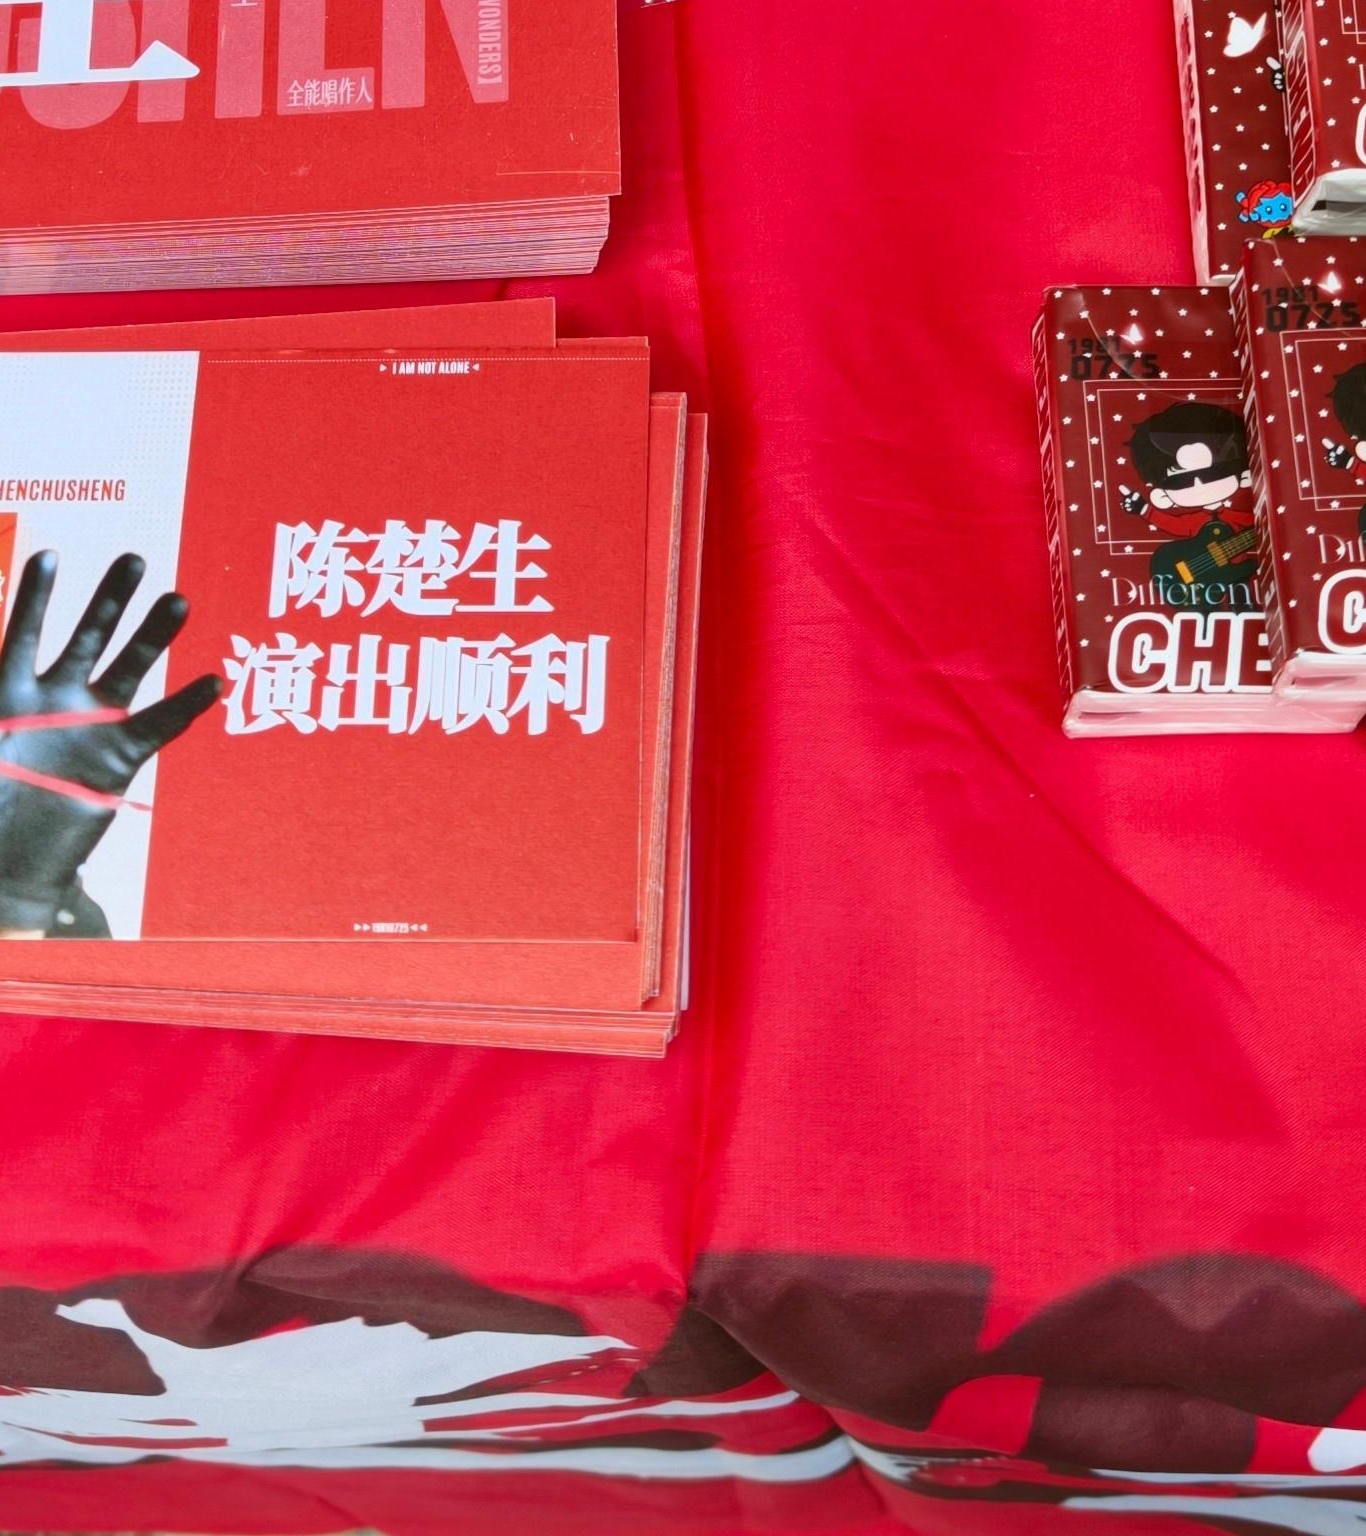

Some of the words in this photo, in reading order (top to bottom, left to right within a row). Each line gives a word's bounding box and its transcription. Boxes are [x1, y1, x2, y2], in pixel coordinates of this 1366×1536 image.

[286, 77, 373, 107] 全能唱作人
[1265, 302, 1362, 333] 0725
[398, 361, 415, 375] AM
[417, 361, 437, 375] NOT
[438, 360, 470, 375] ALONE
[1070, 353, 1161, 381] 0725
[268, 519, 555, 618] 陈楚生
[1108, 612, 1274, 694] CHE
[222, 632, 611, 736] 演出顺利
